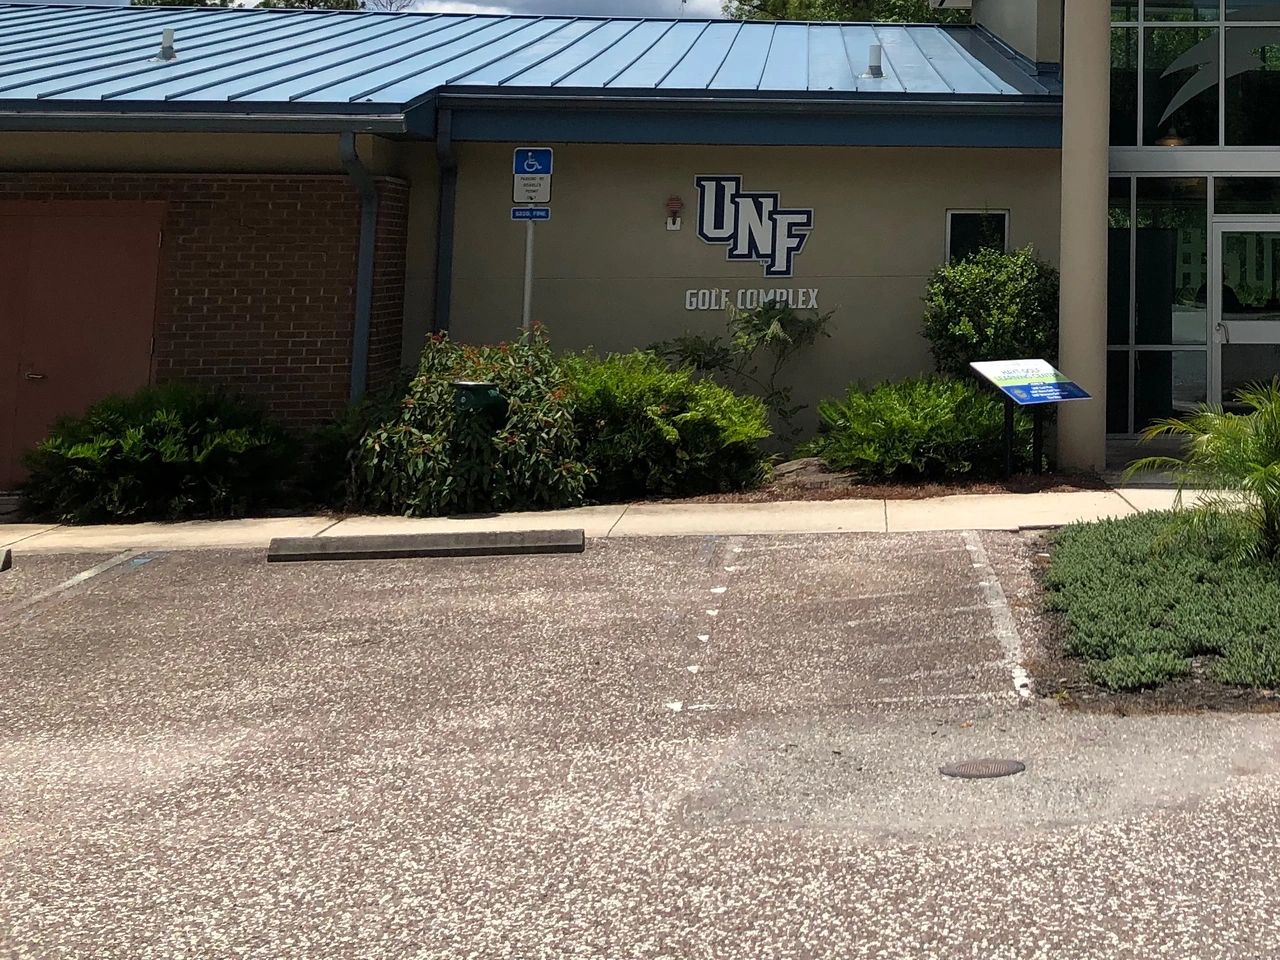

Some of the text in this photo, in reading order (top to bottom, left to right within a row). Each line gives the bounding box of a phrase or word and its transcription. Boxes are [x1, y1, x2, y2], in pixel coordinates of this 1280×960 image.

[698, 178, 811, 275] UNF
[685, 289, 818, 310] GOLF COMPLEX
